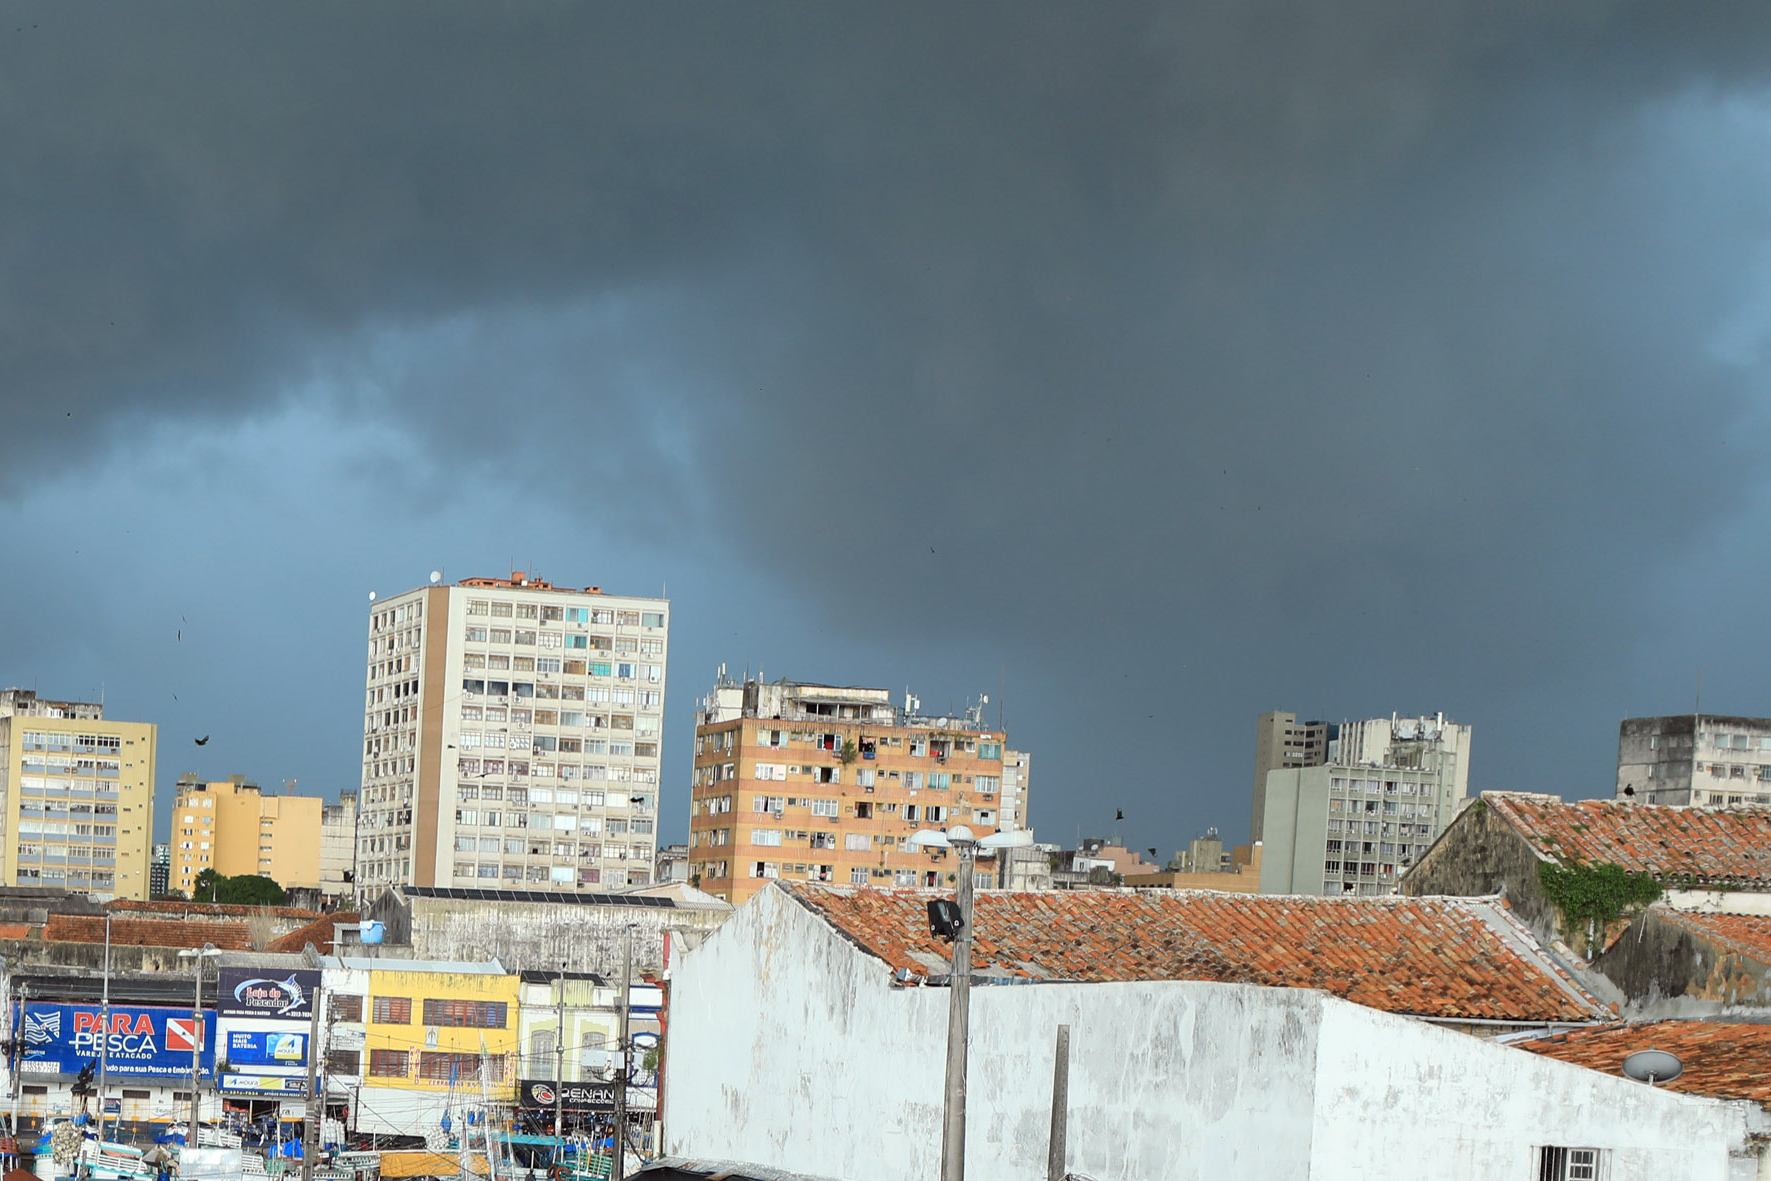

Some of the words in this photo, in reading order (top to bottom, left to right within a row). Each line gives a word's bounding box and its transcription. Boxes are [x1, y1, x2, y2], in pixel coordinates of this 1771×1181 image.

[246, 987, 268, 999] Loja
[269, 988, 281, 998] do
[246, 996, 288, 1008] Pescador
[74, 1012, 155, 1036] PARA
[69, 1032, 157, 1054] PESCA
[148, 1065, 167, 1073] Pesca
[173, 1066, 210, 1075] Embarcção.
[562, 1088, 614, 1099] RENAN
